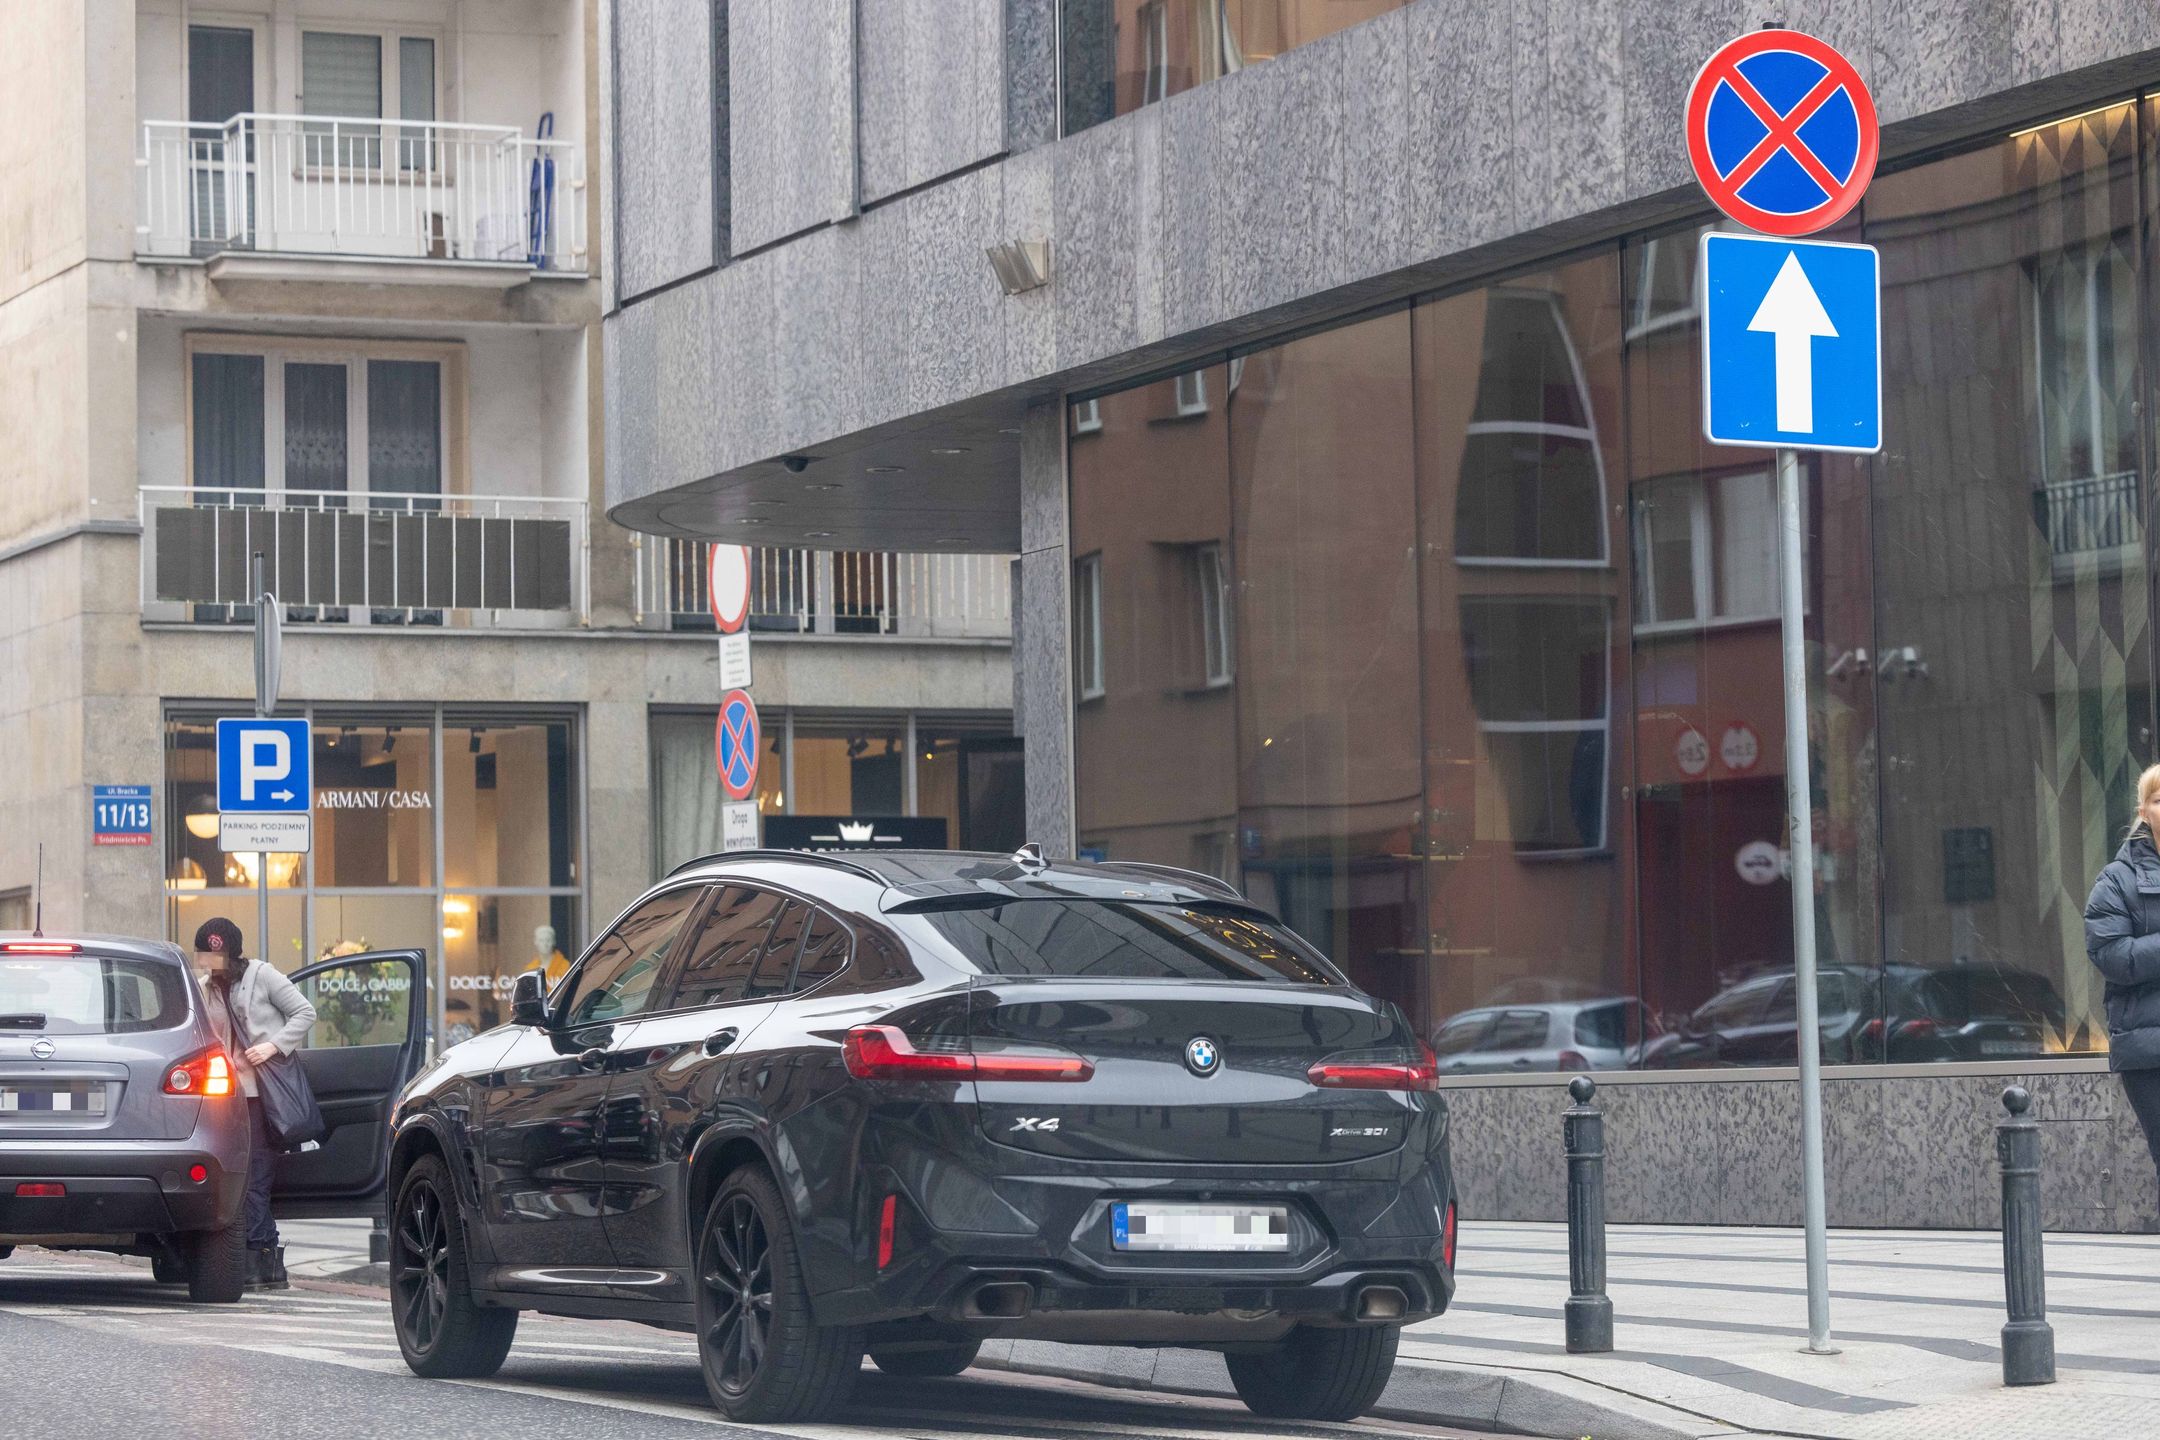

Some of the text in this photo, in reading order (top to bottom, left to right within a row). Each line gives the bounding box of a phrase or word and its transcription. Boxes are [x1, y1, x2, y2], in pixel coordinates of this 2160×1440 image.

[240, 730, 291, 801] P
[117, 787, 139, 795] Bracka
[317, 790, 379, 808] ARMANI
[388, 790, 432, 808] CASA
[98, 803, 149, 828] 11/13
[731, 809, 748, 828] Droga
[223, 823, 306, 831] PARKING PODZIEMNY
[250, 836, 279, 844] PŁATNY
[1009, 1117, 1060, 1132] X4
[1116, 1228, 1128, 1239] PL
